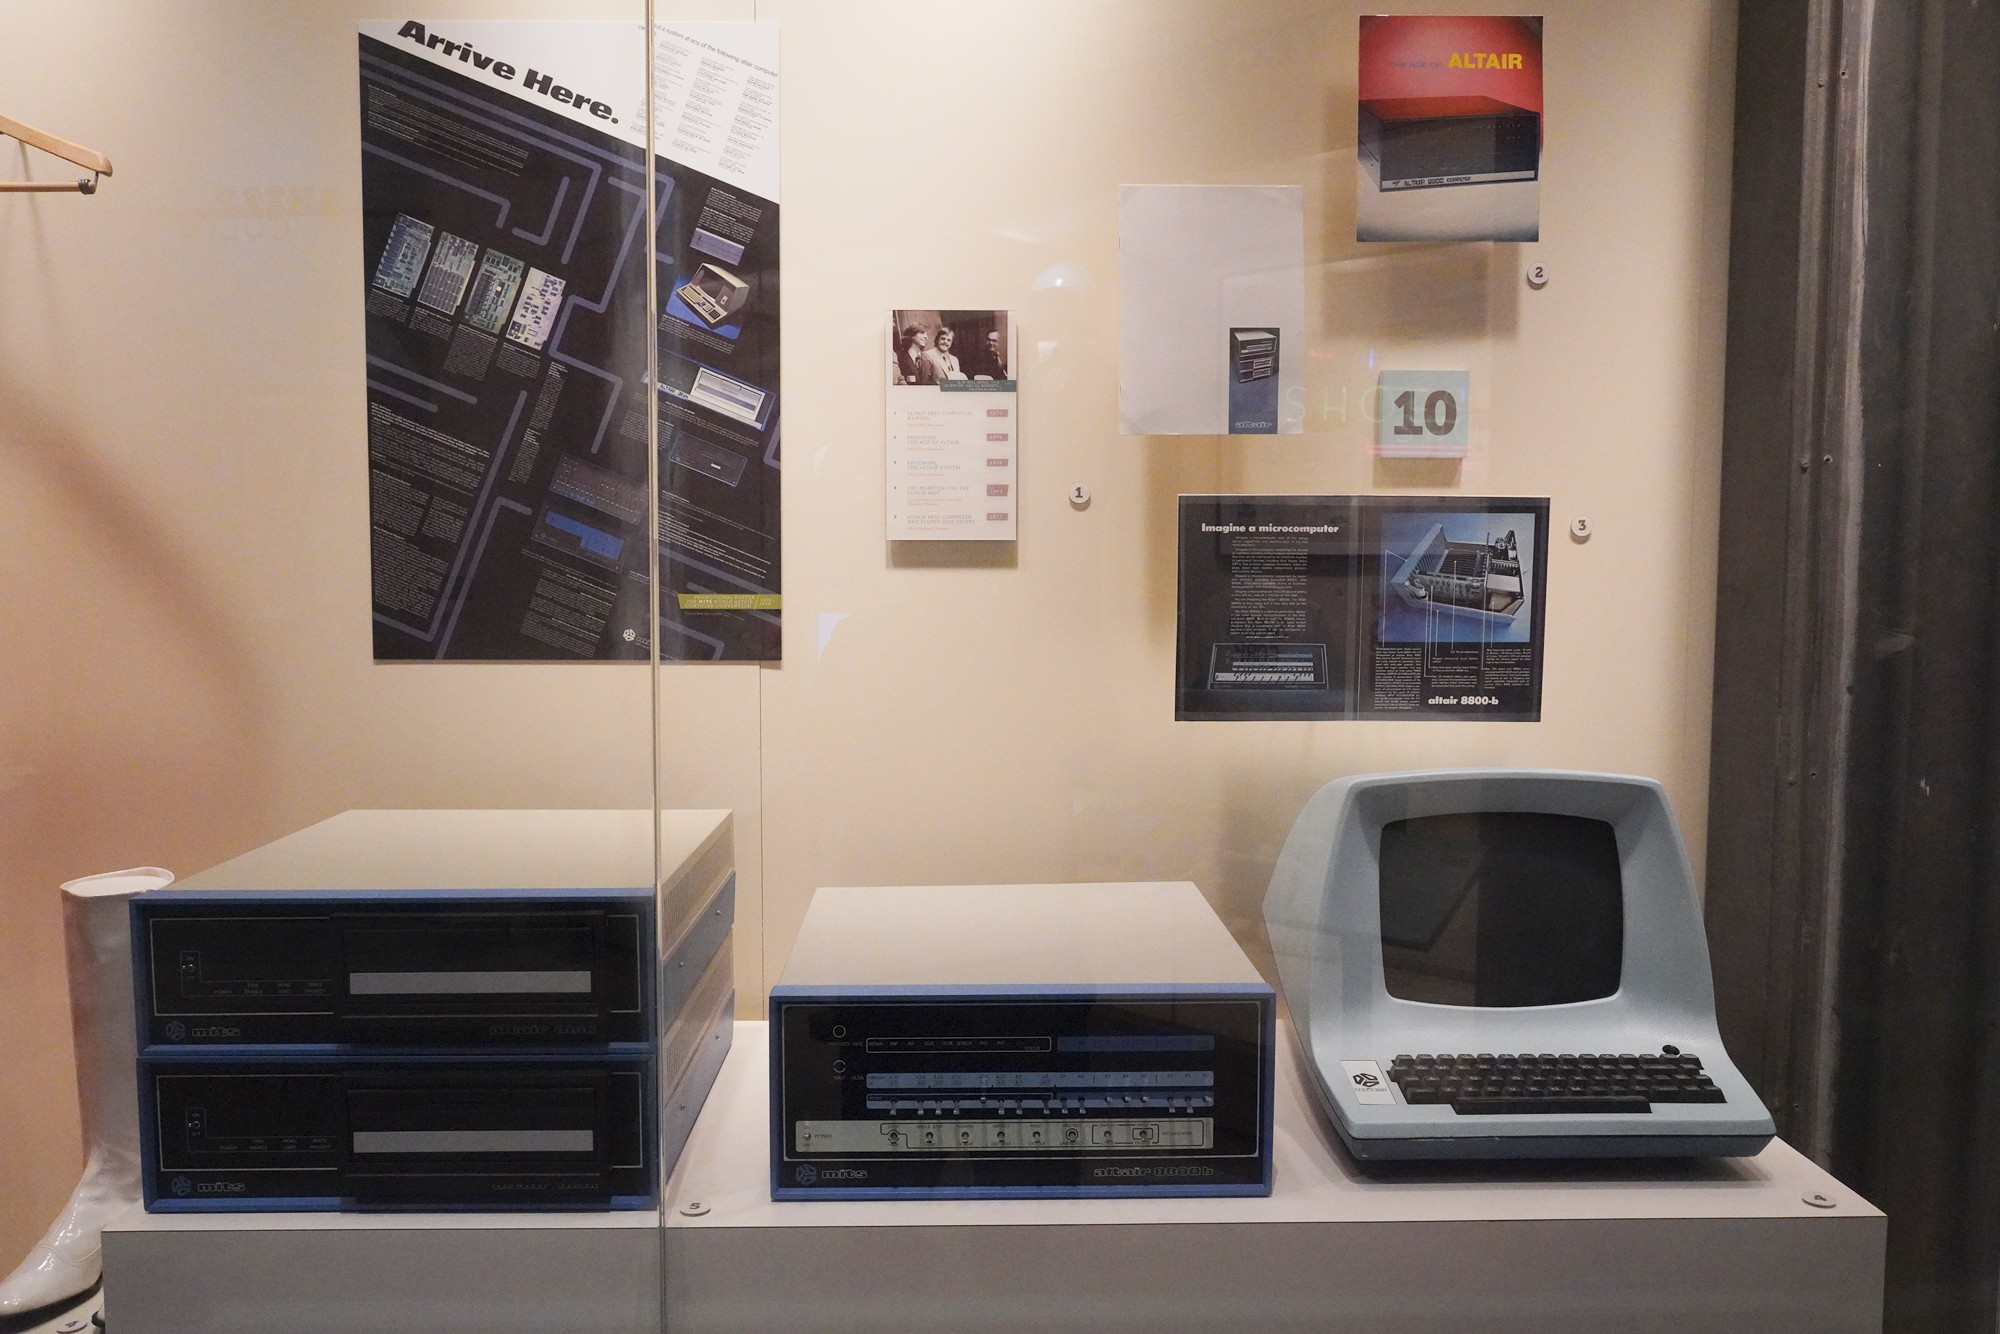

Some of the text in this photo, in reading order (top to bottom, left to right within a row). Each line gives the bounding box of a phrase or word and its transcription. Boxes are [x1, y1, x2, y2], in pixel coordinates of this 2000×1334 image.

[666, 29, 685, 39] system
[690, 39, 701, 47] any
[717, 49, 741, 63] following
[741, 58, 754, 68] altair
[754, 65, 779, 77] computer
[1448, 53, 1523, 69] ALTAIR
[397, 20, 516, 80] Arrive
[522, 69, 619, 125] Here.
[1535, 266, 1543, 278] 2
[1394, 390, 1457, 435] 10
[1074, 487, 1084, 498] 1
[1201, 523, 1246, 533] Imagine
[1258, 523, 1339, 534] microcomputer
[1578, 520, 1586, 531] 3
[1428, 695, 1499, 706] altair 8800-b
[192, 1026, 240, 1037] mits
[823, 1169, 868, 1178] mits
[1094, 1167, 1151, 1177] altair
[198, 1182, 245, 1192] mits
